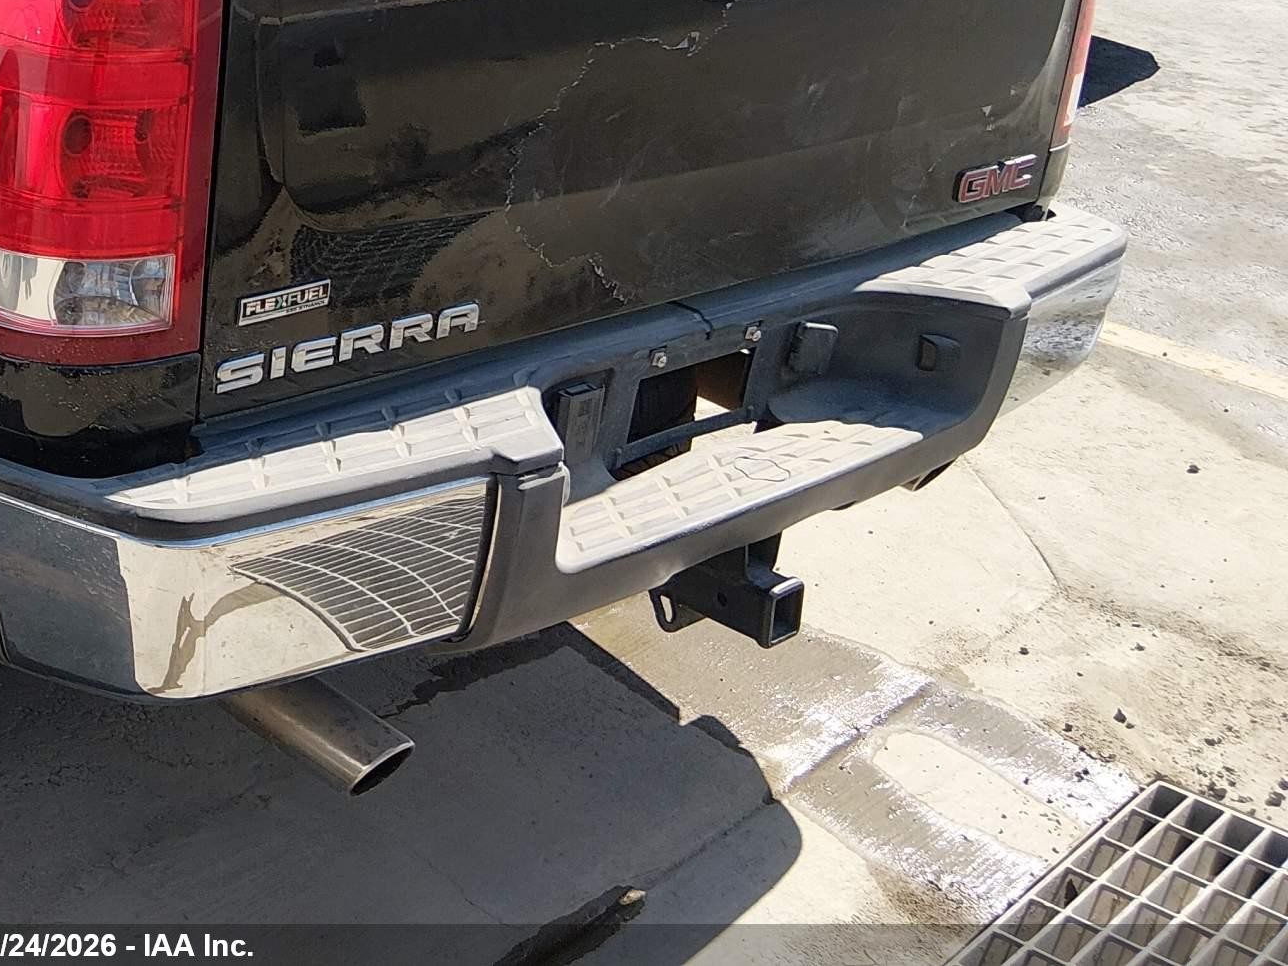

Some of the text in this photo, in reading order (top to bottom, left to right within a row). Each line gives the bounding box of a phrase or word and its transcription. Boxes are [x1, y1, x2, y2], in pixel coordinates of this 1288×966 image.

[958, 153, 1038, 204] GMC
[245, 285, 327, 316] FLEXFUEL
[216, 300, 481, 395] SIERRA
